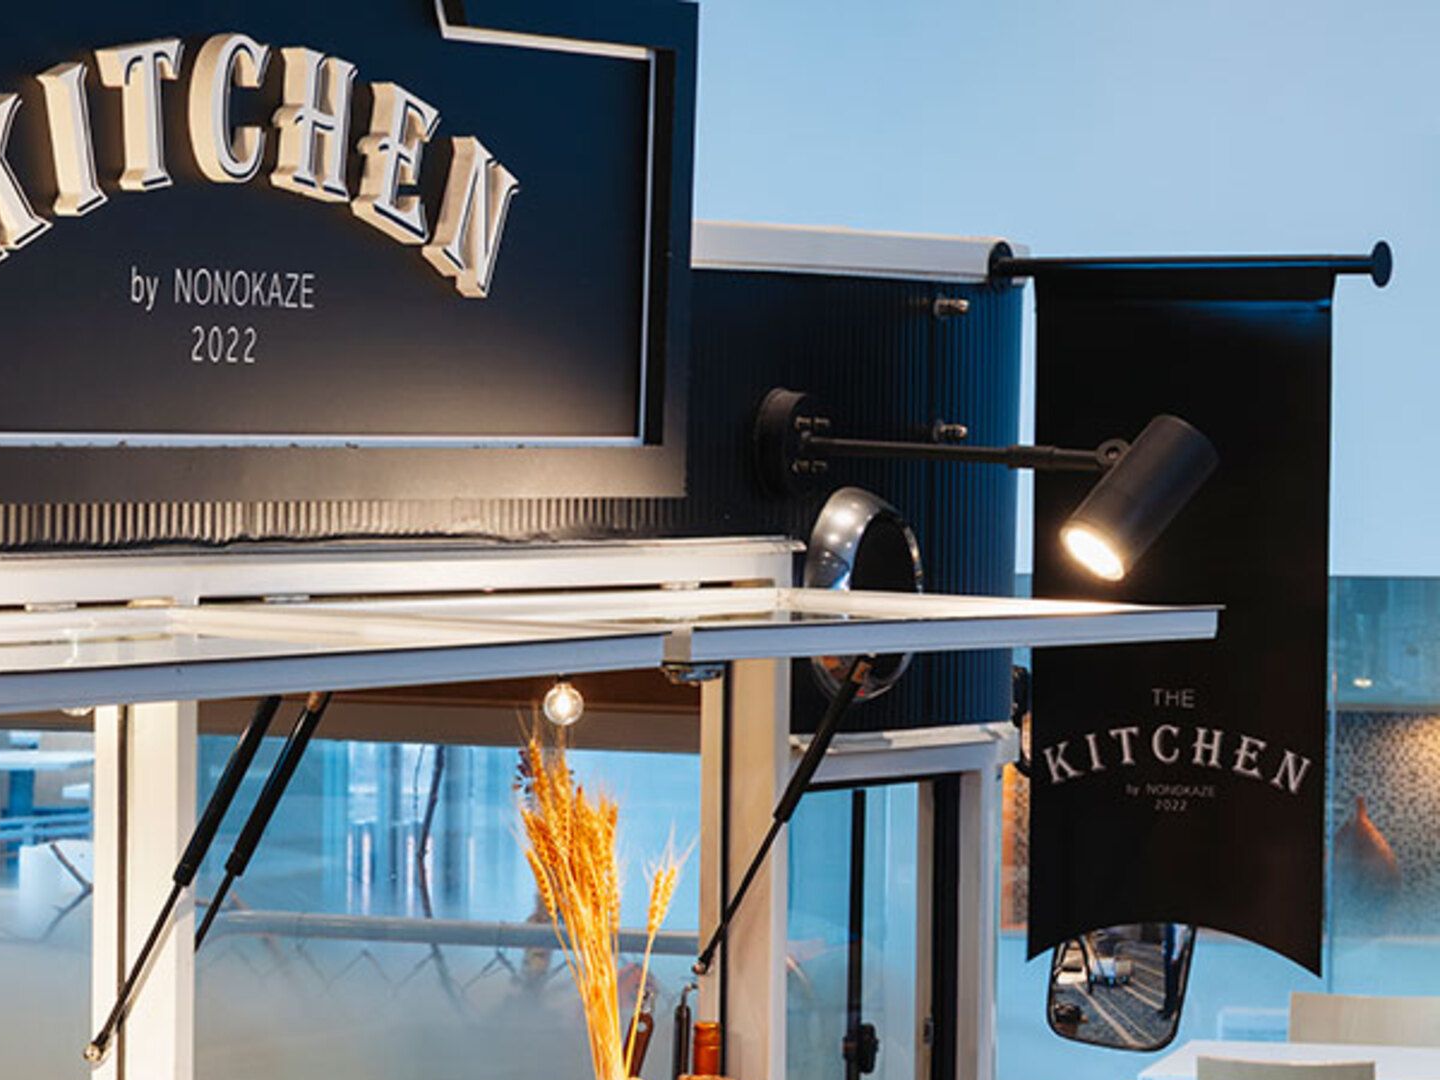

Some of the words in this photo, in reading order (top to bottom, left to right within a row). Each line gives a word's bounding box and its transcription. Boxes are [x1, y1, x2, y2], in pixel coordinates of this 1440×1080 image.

[130, 267, 159, 311] by
[173, 268, 315, 309] NONOKAZE
[191, 325, 258, 364] 2022
[1152, 688, 1196, 708] THE
[1042, 724, 1311, 795] KITCHEN
